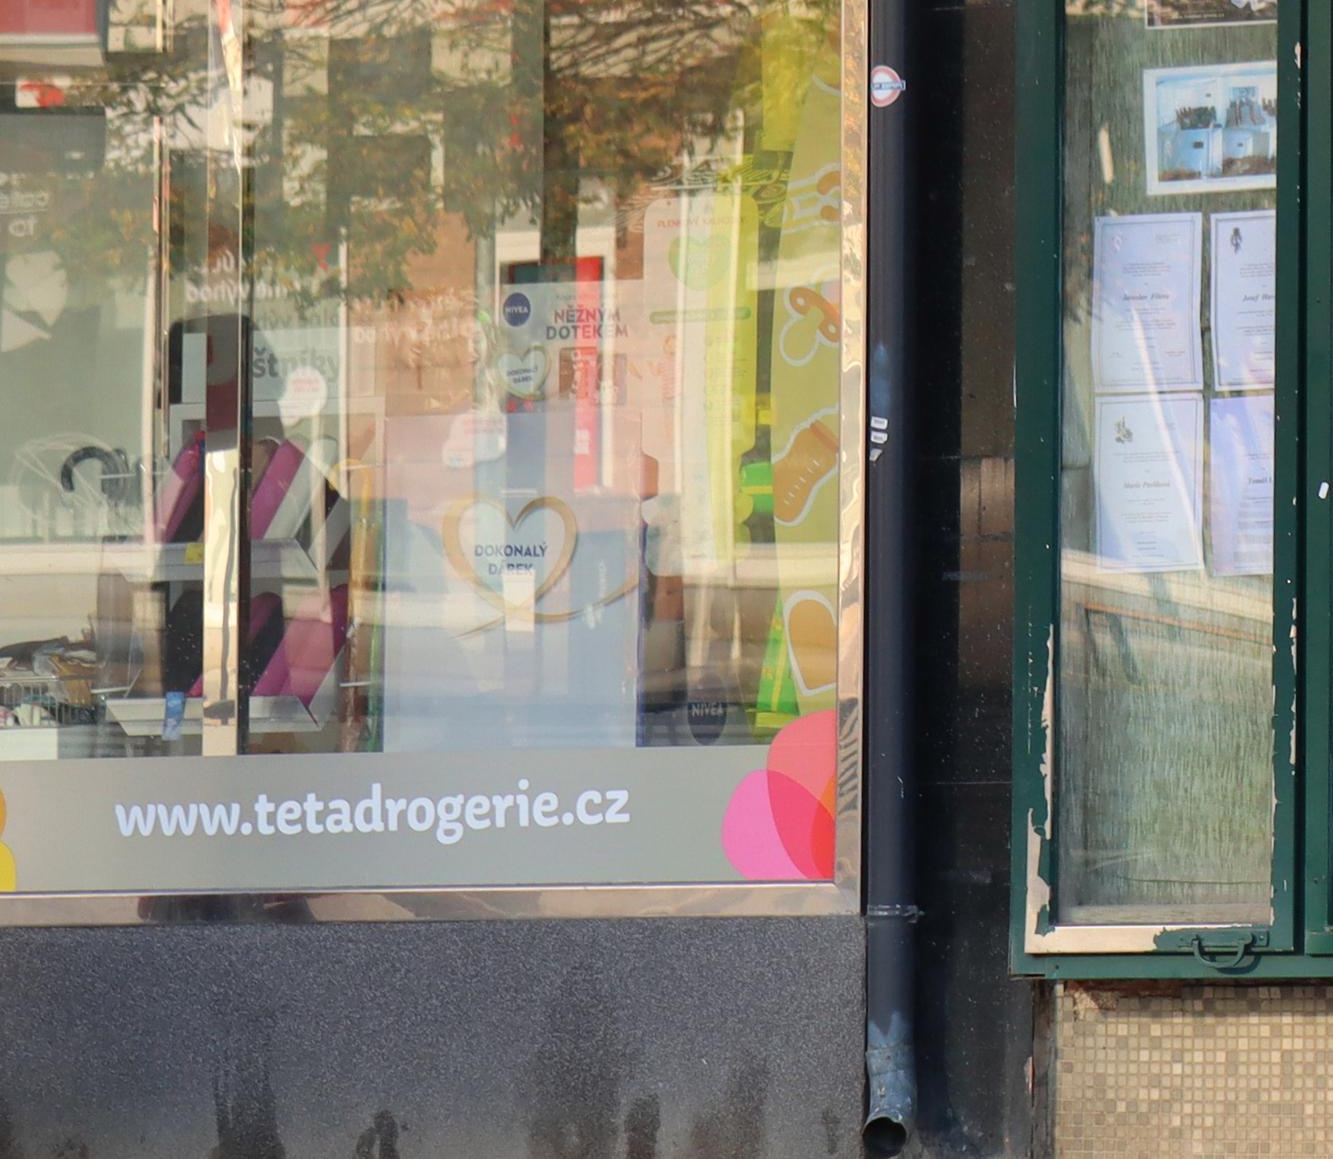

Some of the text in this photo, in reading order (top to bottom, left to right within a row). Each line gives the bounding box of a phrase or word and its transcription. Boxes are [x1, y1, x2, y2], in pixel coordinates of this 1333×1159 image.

[505, 306, 529, 314] NIVEA
[474, 541, 548, 557] DOKONALÝ
[692, 702, 723, 718] NIVEA
[115, 778, 631, 844] www.tetadrogerie.cz
